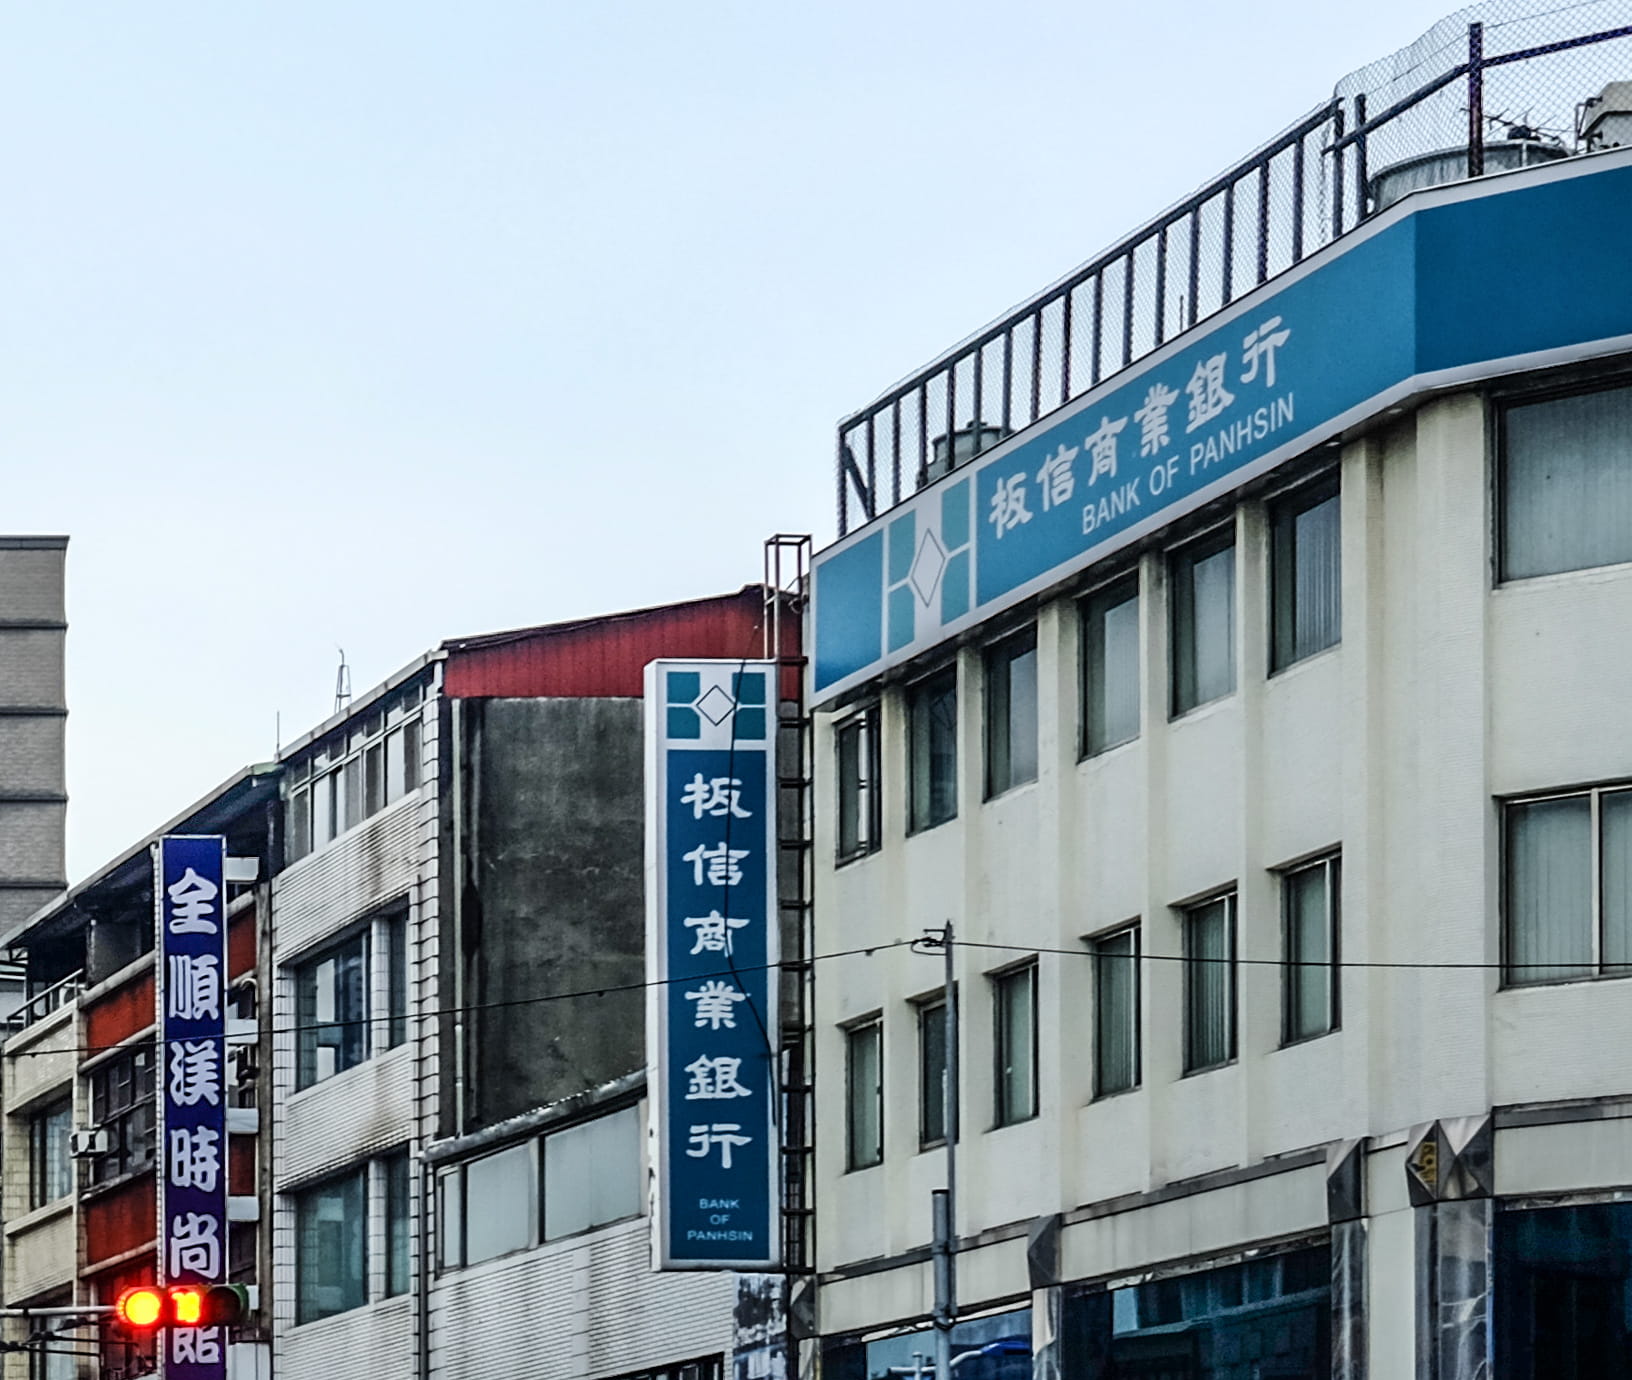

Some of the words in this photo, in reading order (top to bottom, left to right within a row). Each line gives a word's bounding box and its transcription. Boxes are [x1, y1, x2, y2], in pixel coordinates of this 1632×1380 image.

[989, 315, 1291, 540] 板信商業銀行
[1083, 478, 1141, 535] BANK
[1149, 456, 1180, 496] OF
[1190, 391, 1294, 476] PANHSIN
[681, 772, 752, 1169] 板信商業銀行
[687, 1230, 753, 1241] PANHSIN
[699, 1199, 740, 1209] BANK
[709, 1215, 730, 1224] OF
